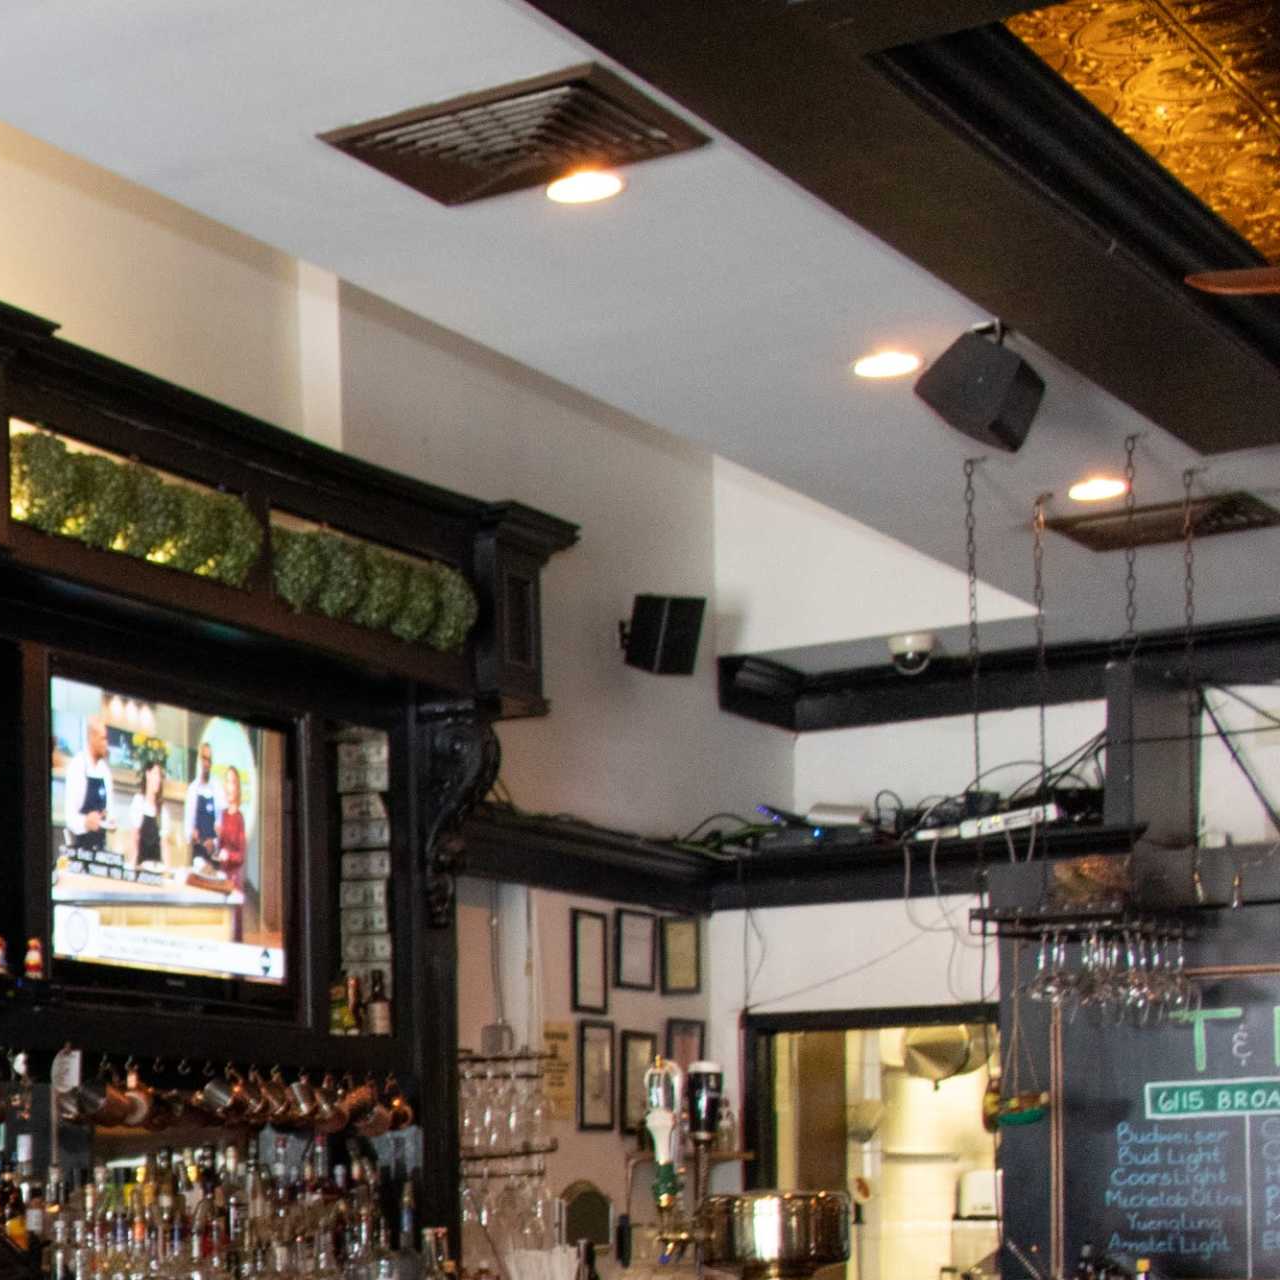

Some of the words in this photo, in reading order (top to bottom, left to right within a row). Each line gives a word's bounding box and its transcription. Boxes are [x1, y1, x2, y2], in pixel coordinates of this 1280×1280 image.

[1169, 1007, 1242, 1072] T
[1158, 1090, 1204, 1114] 6115
[1117, 1121, 1228, 1144] Budweiser
[1118, 1144, 1161, 1165] Bud
[1168, 1146, 1222, 1173] Light
[1111, 1167, 1170, 1186] Coors
[1174, 1167, 1227, 1189] Light
[1105, 1189, 1188, 1208] Michelob
[1126, 1212, 1223, 1233] Yuengling
[1180, 1234, 1232, 1261] Light
